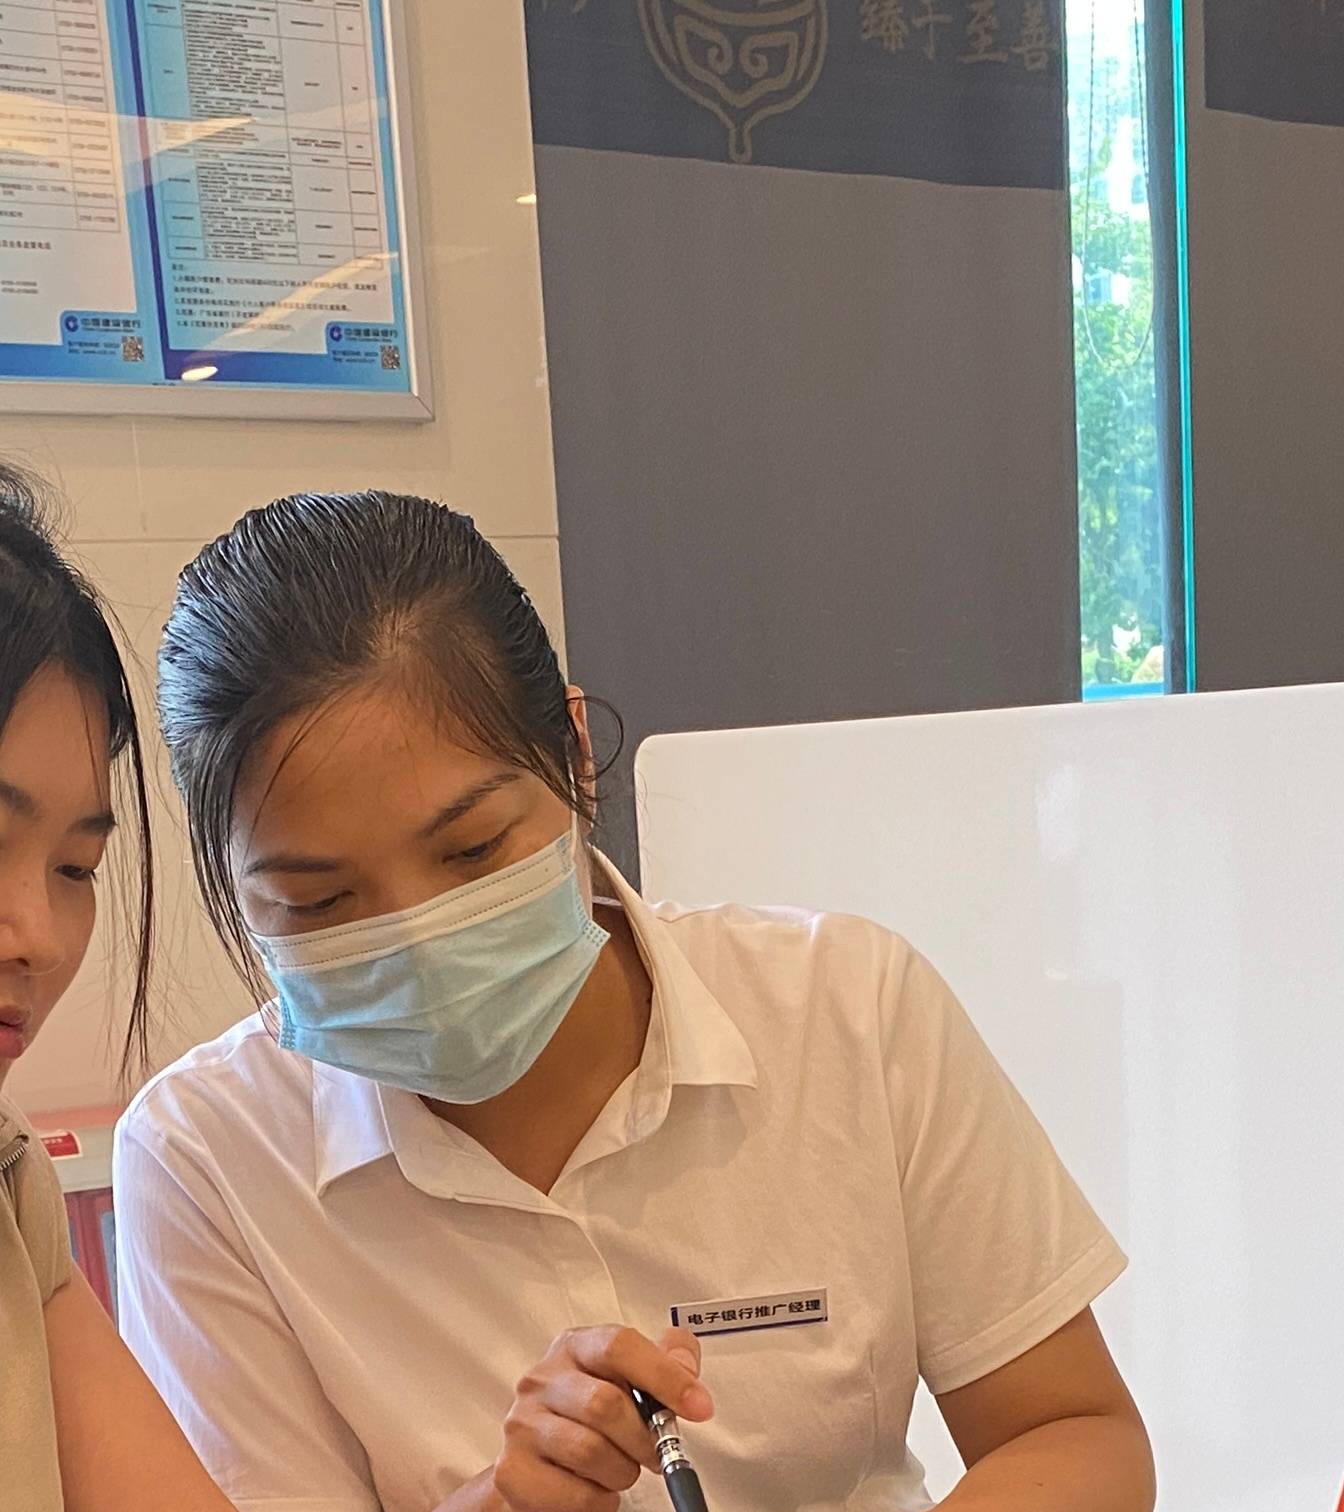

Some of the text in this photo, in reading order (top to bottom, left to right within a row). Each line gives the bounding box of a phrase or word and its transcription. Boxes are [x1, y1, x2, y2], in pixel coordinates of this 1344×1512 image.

[688, 1299, 821, 1325] 电子银行推广经理
